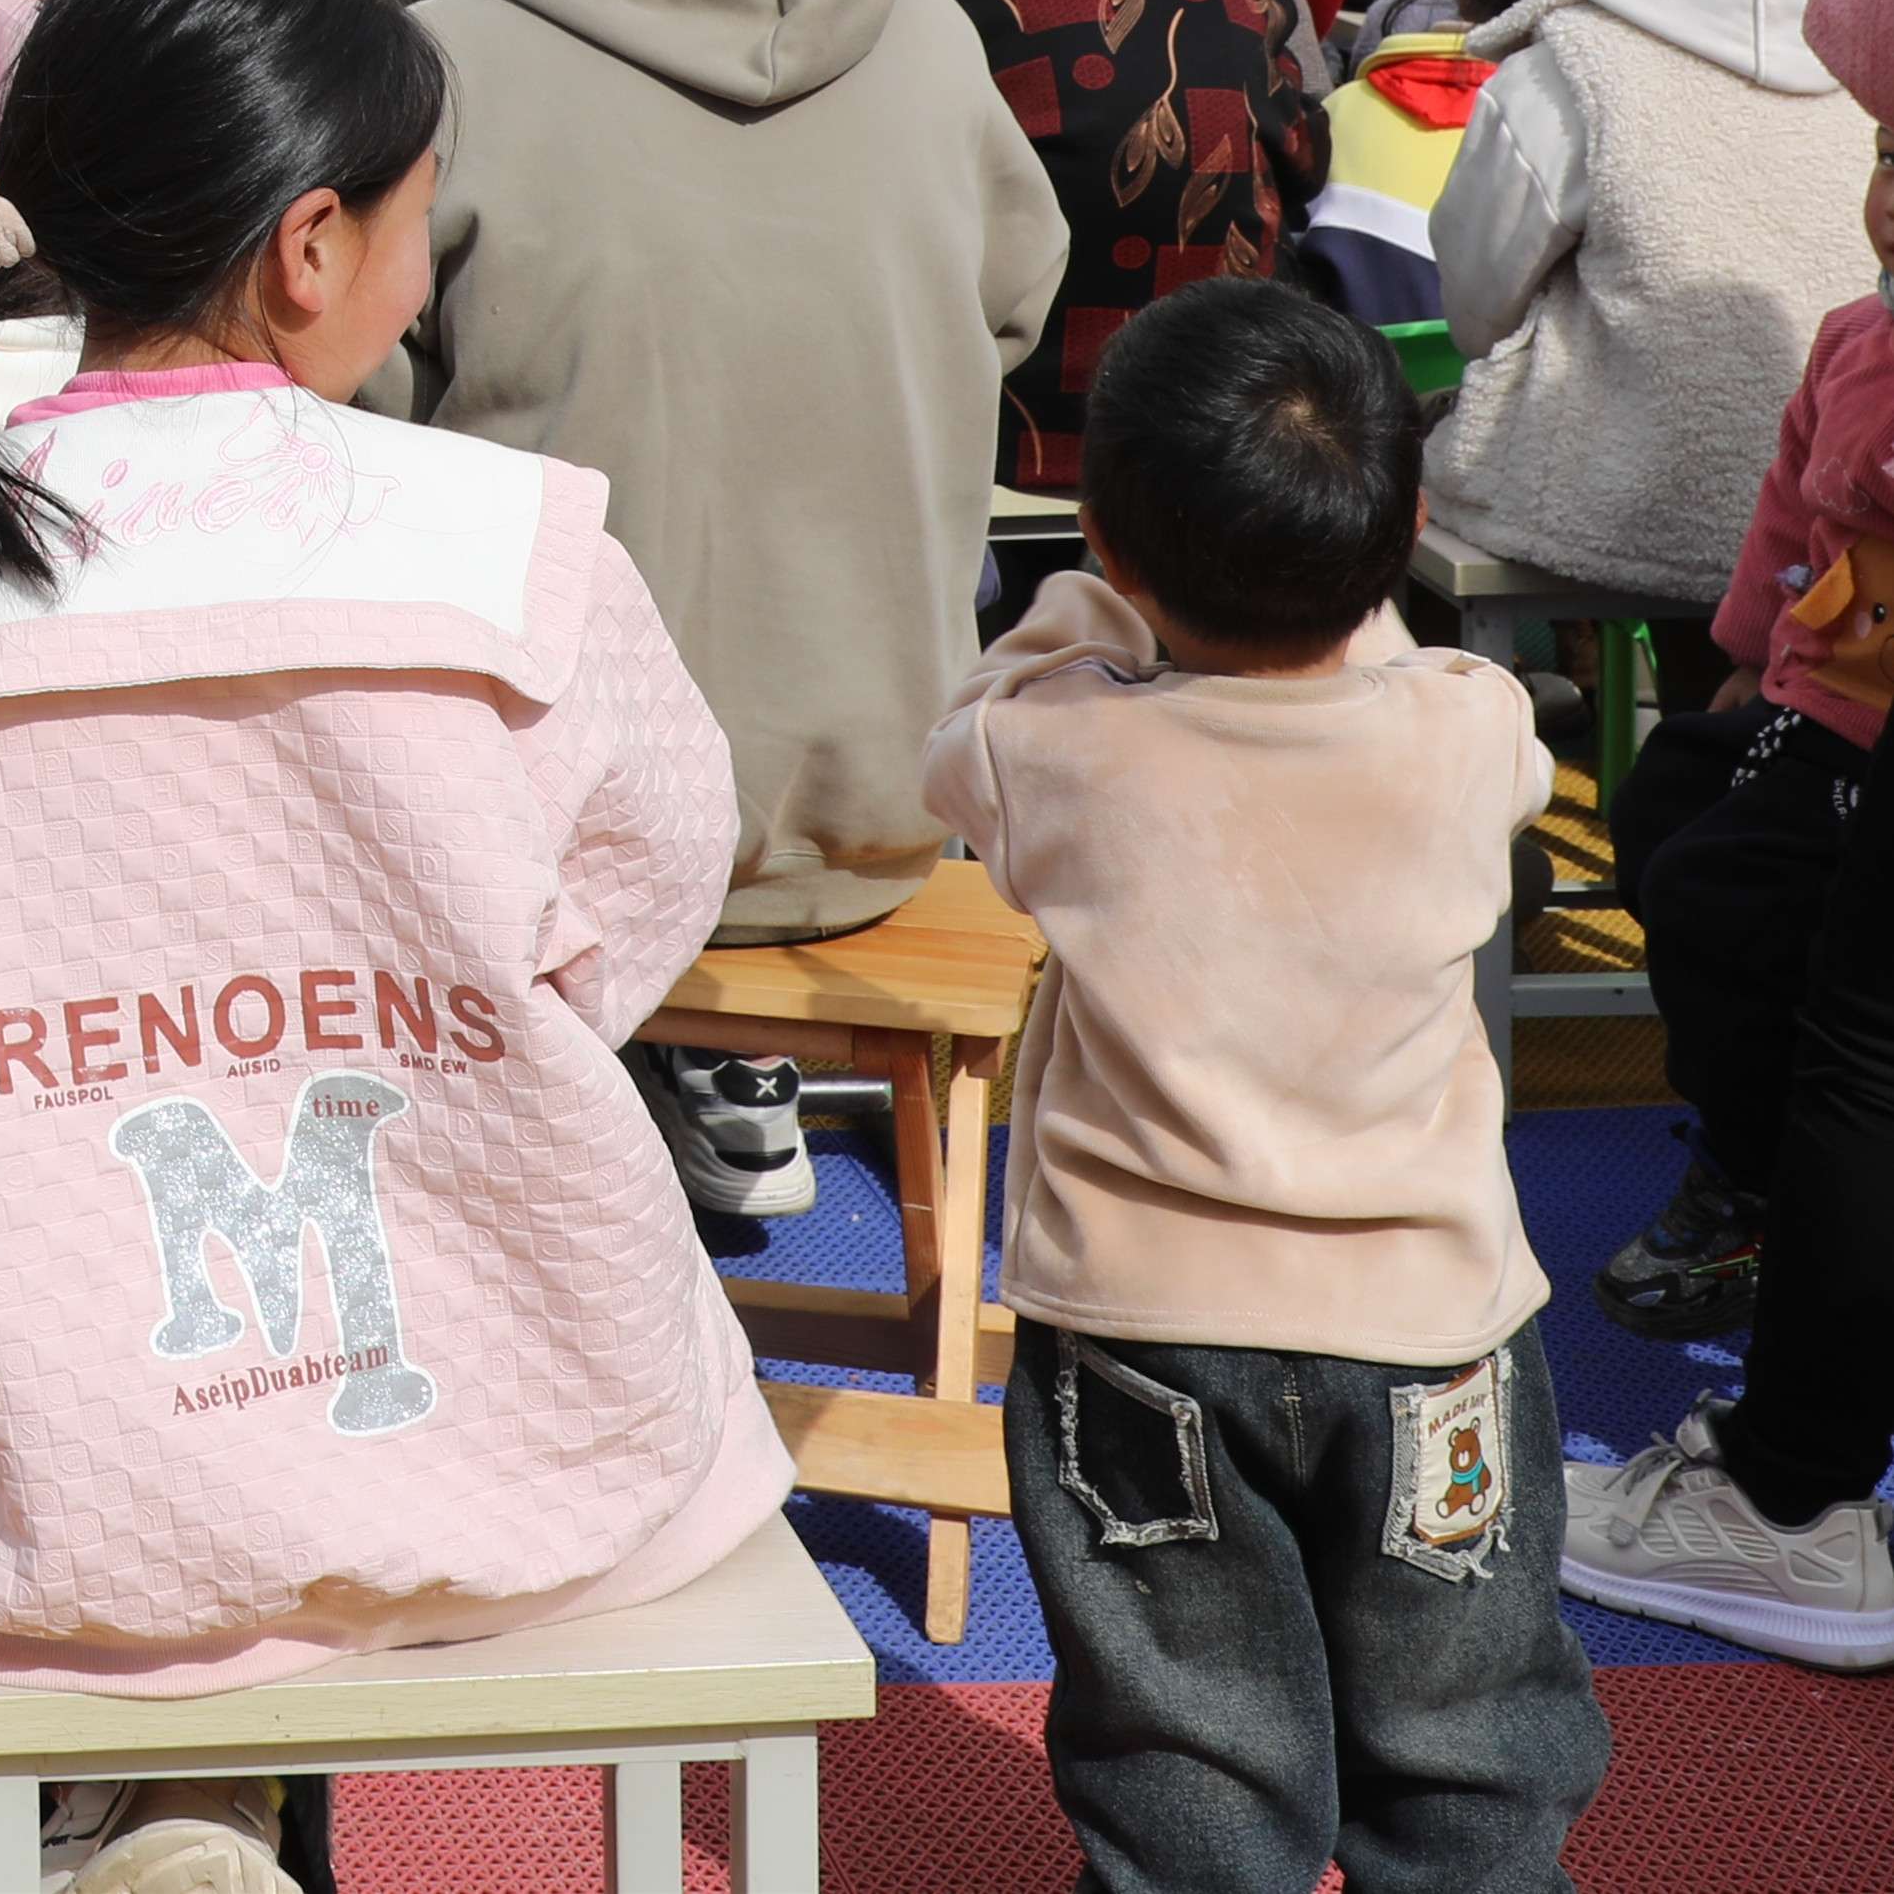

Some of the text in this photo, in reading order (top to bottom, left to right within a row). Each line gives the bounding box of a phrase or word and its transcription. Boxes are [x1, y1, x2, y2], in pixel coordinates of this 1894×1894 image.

[227, 1057, 282, 1078] AUSID
[34, 1086, 114, 1110] FAUSPOL
[313, 1094, 381, 1118] time
[1428, 1397, 1469, 1438] MADE
